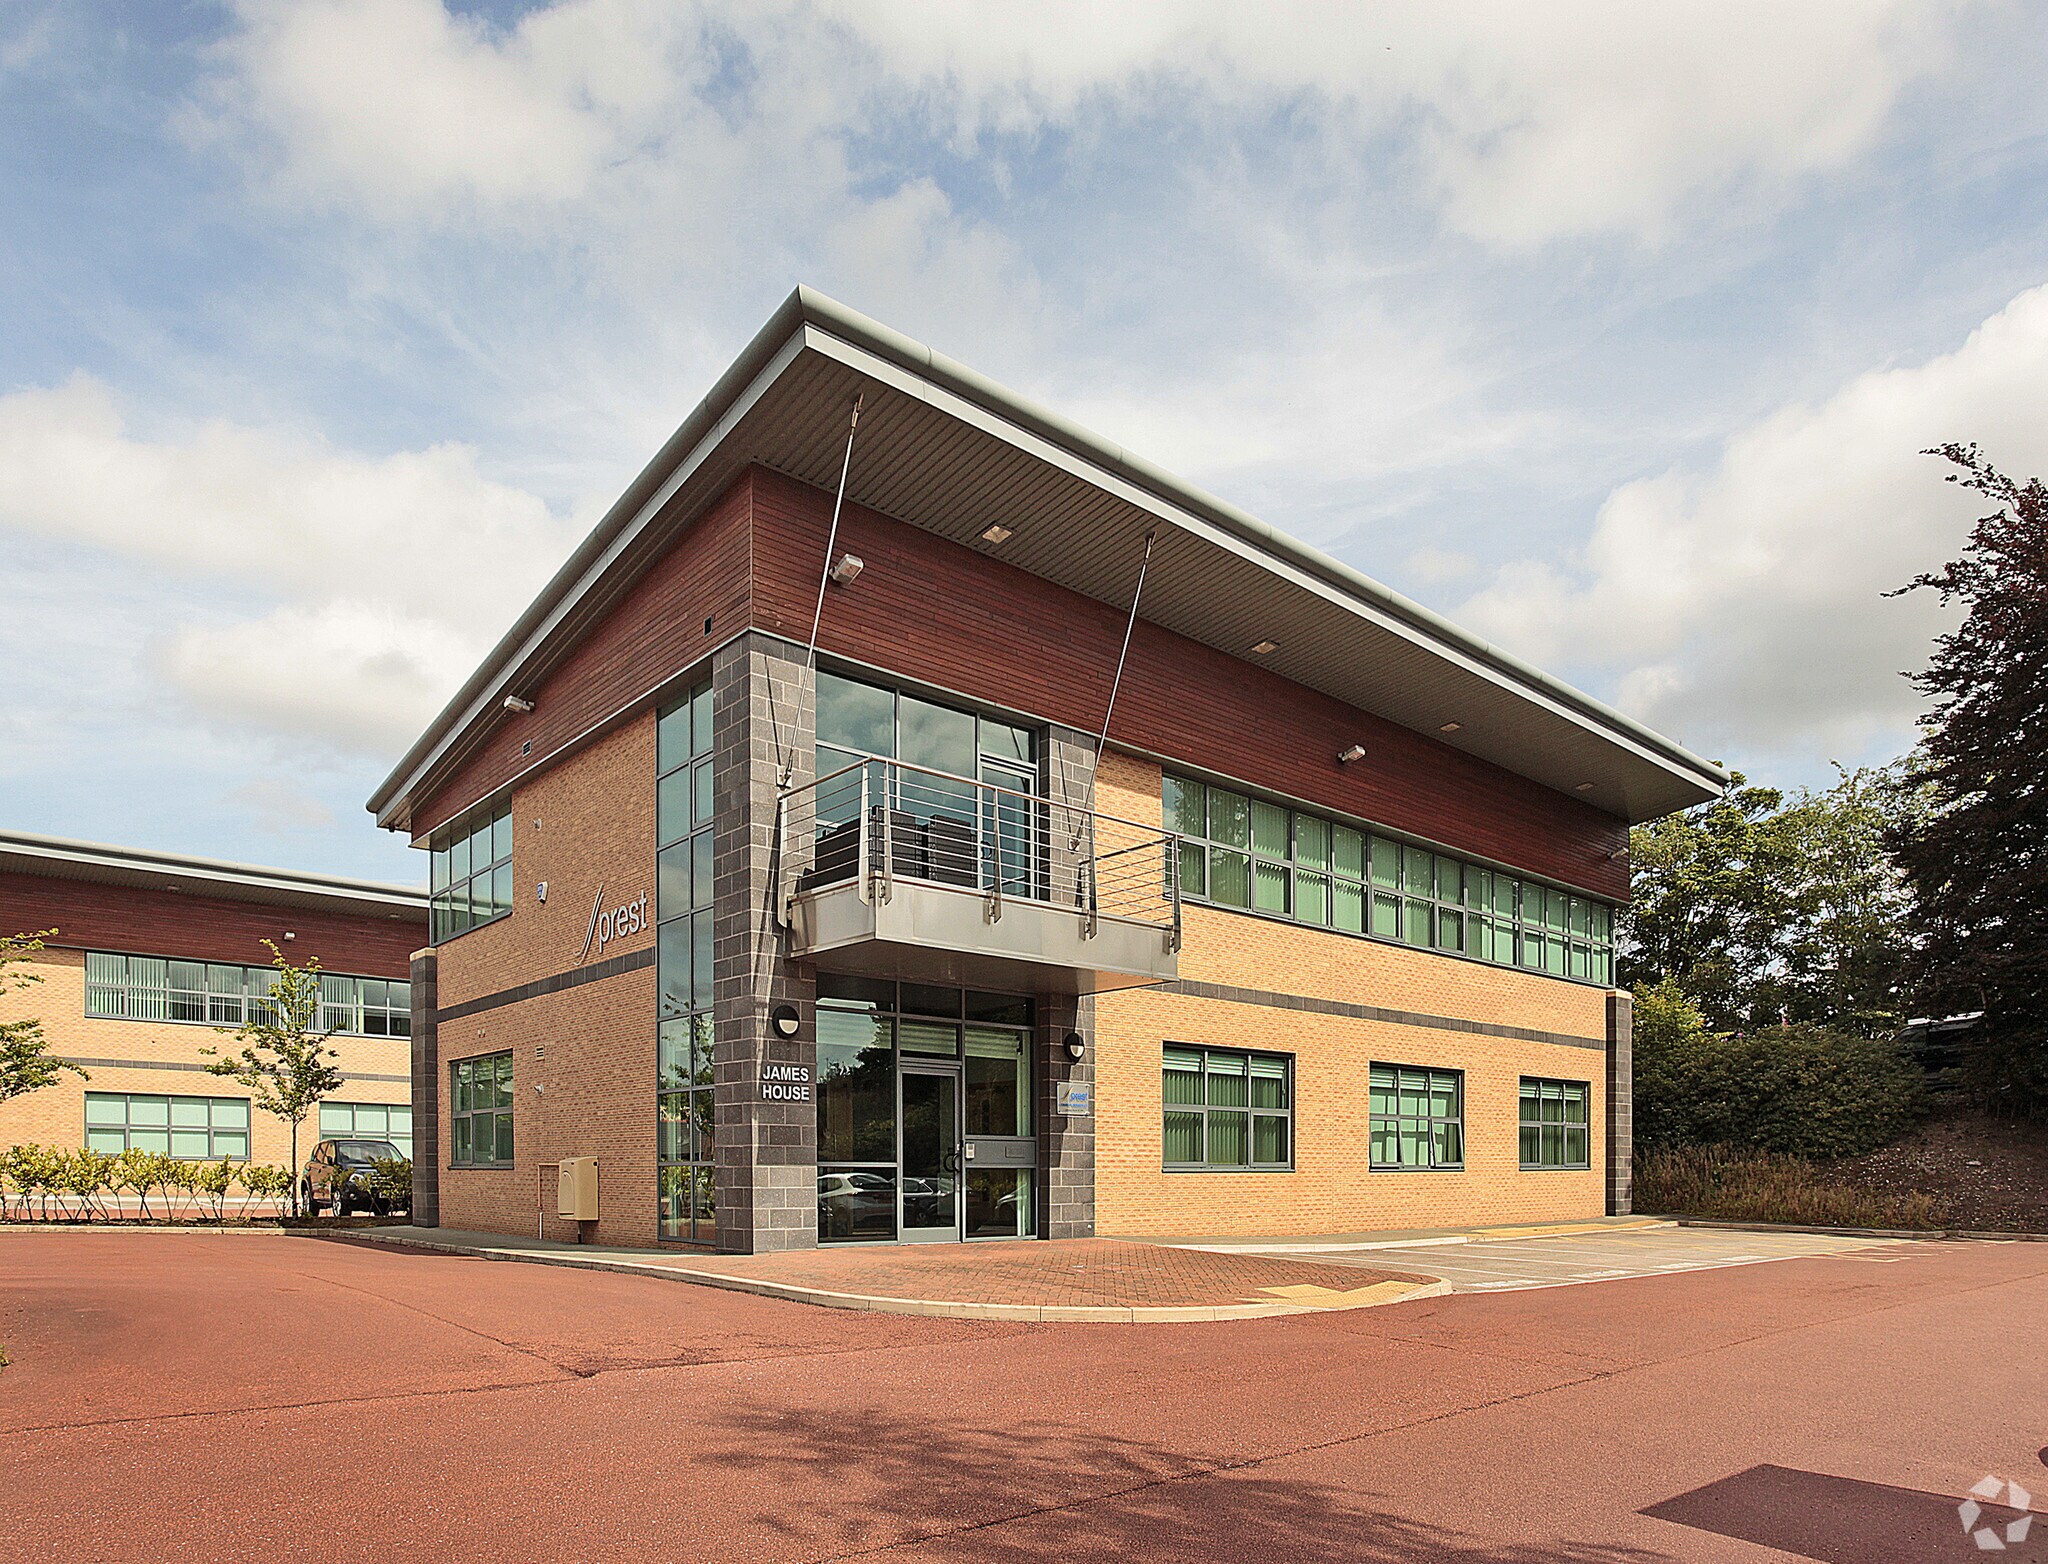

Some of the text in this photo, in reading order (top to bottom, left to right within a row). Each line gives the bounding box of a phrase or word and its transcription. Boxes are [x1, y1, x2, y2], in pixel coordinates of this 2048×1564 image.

[599, 889, 647, 953] prest
[762, 1065, 809, 1081] JAMES
[762, 1084, 810, 1100] HOUSE
